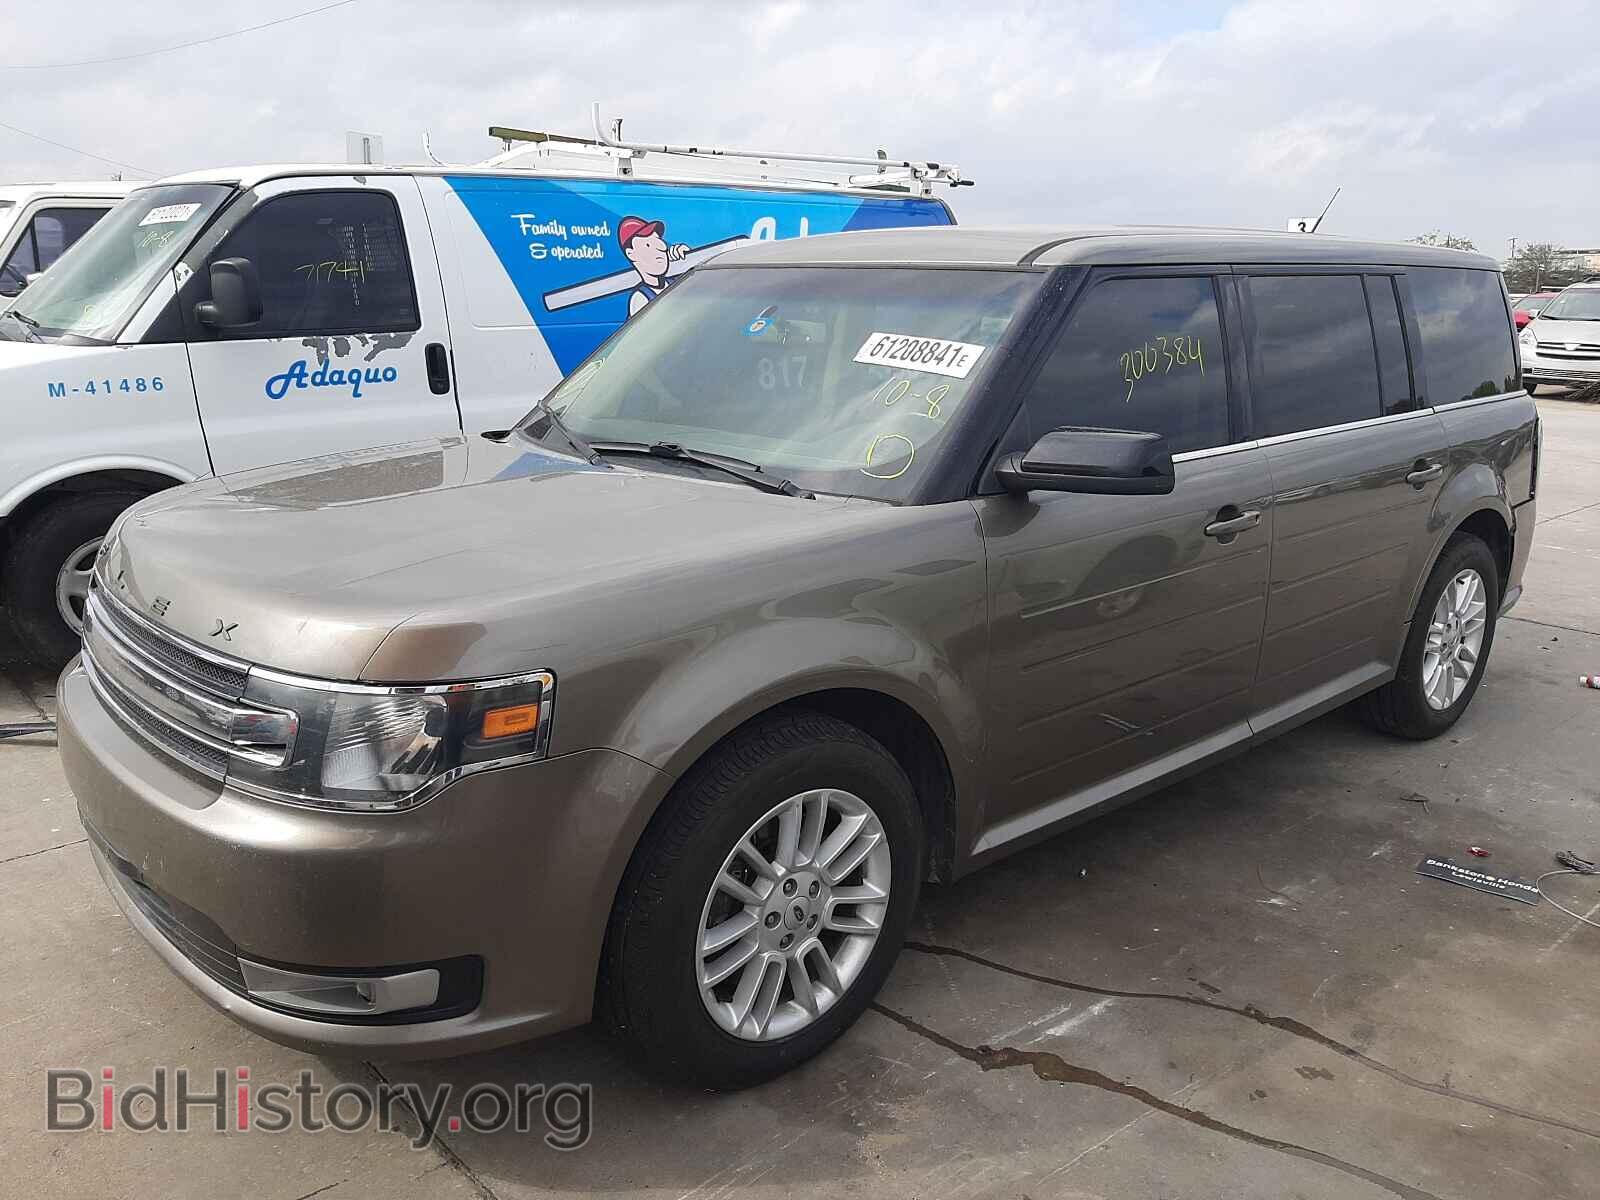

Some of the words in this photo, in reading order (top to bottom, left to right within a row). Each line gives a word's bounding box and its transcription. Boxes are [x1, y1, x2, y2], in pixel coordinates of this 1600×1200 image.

[510, 213, 567, 240] Family
[571, 220, 611, 236] owned
[529, 243, 548, 259] &
[551, 243, 605, 260] operated
[265, 359, 398, 400] Adaquo
[1120, 335, 1205, 403] 300384
[1451, 871, 1506, 889] Lewisville
